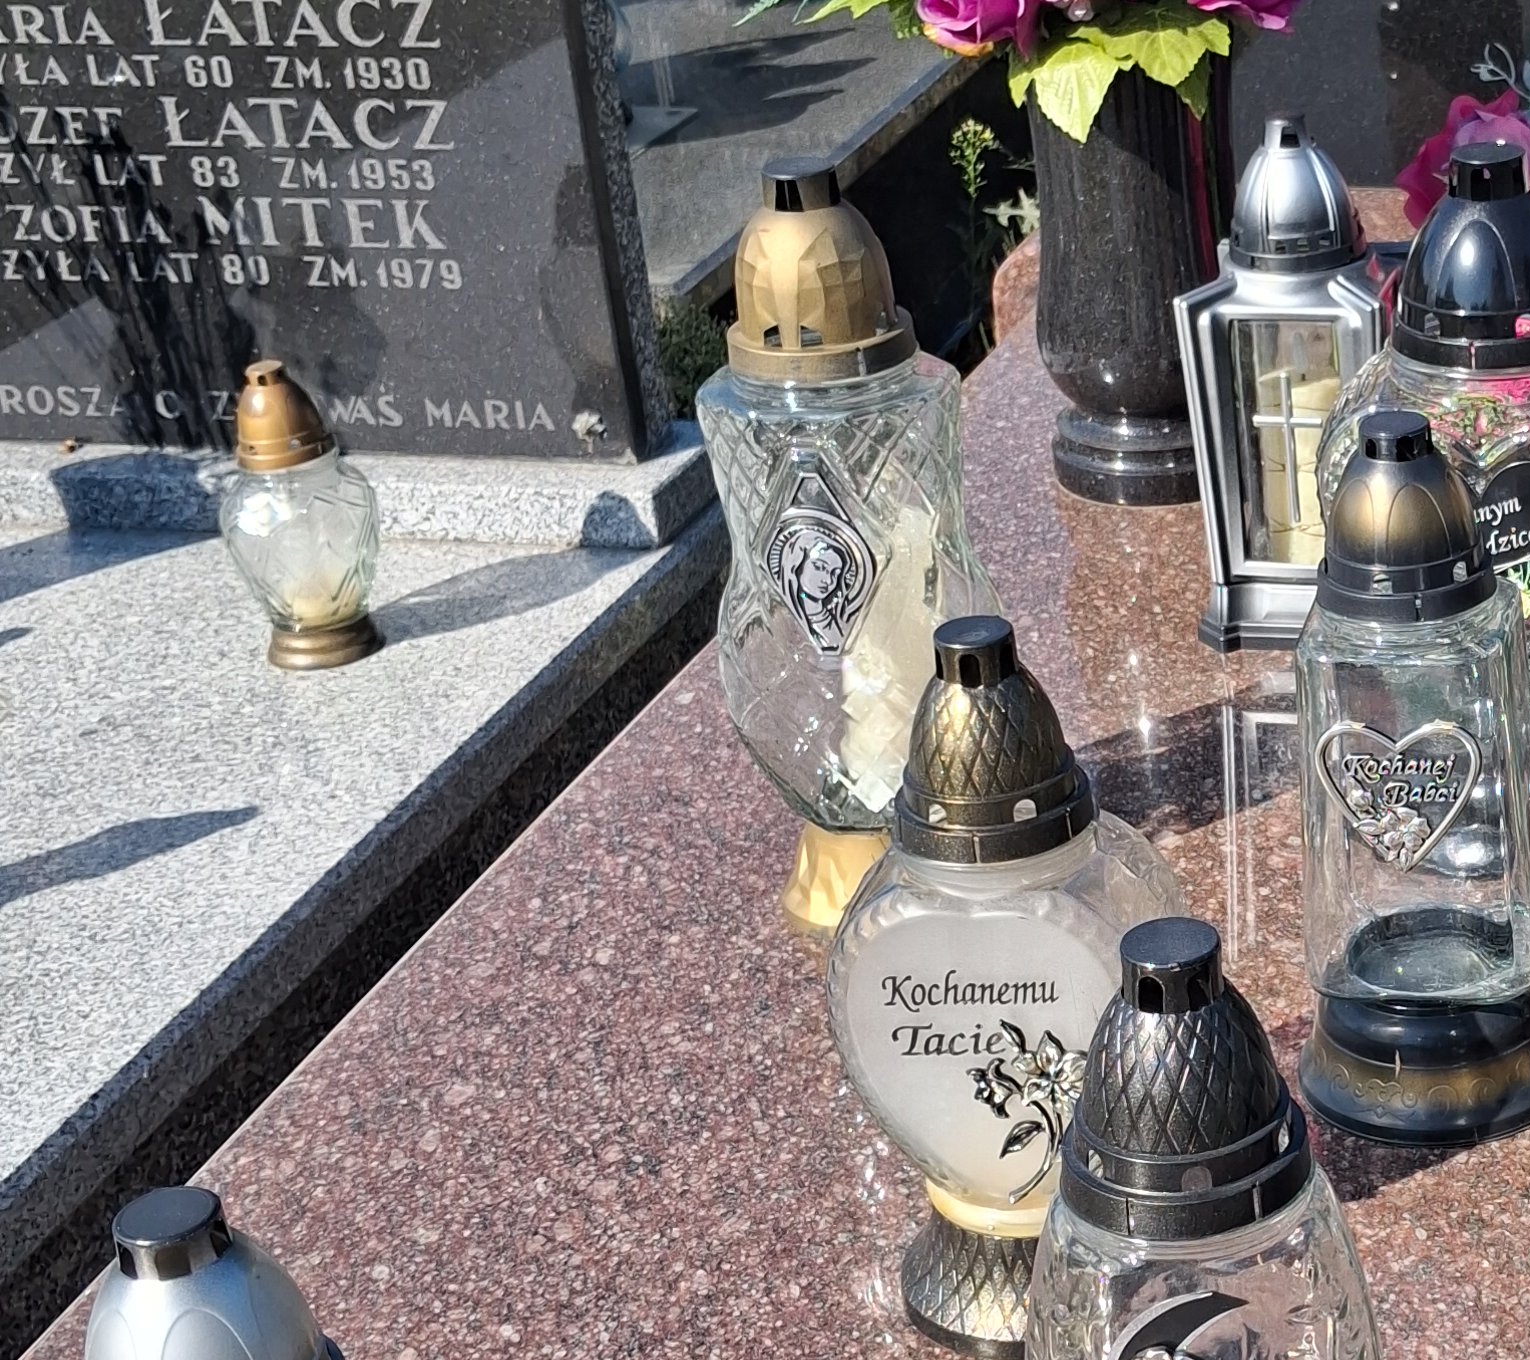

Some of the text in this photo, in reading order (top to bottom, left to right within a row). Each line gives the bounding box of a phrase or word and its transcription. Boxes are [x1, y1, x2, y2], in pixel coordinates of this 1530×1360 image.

[86, 52, 161, 88] LAT
[184, 54, 234, 88] 60
[265, 55, 332, 89] ZM.
[343, 56, 432, 90] 1930
[158, 95, 455, 151] ŁATACZ
[93, 152, 168, 187] LAT
[190, 155, 240, 188] 83
[271, 156, 338, 189] ZM.
[348, 157, 436, 191] 1953
[5, 195, 448, 250] ZOFIA MITEK
[125, 251, 199, 284] LAT
[220, 253, 271, 286] 80
[303, 254, 368, 288] ZM.
[376, 257, 463, 290] 1979
[423, 396, 557, 432] MARIA
[1342, 752, 1457, 785] Kochanej
[1383, 780, 1460, 809] Babci
[880, 968, 1061, 1014] Kochanemu
[890, 1022, 1007, 1057] Tacie
